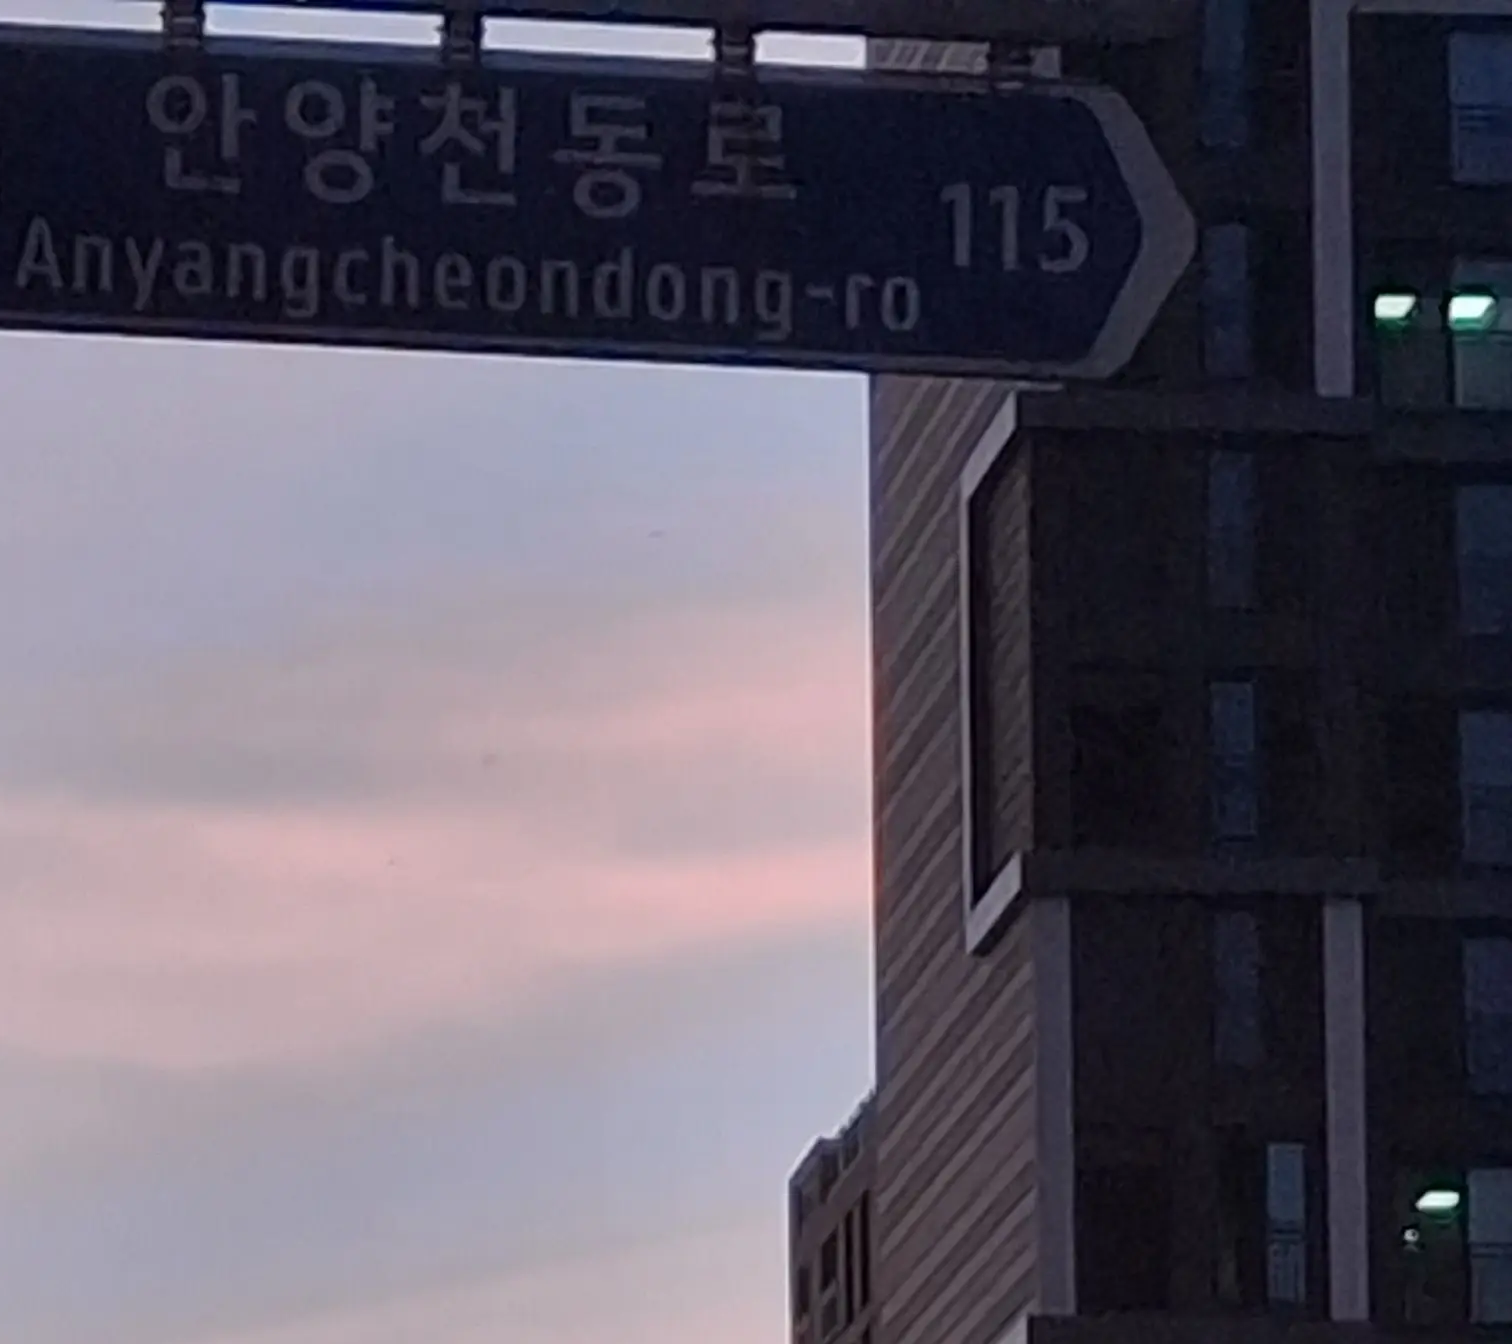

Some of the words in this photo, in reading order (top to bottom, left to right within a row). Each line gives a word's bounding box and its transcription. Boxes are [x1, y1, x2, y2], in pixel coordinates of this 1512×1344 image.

[144, 72, 798, 219] 안양천동로
[14, 213, 922, 342] Anyangcheondong-ro
[938, 180, 1091, 275] 115
